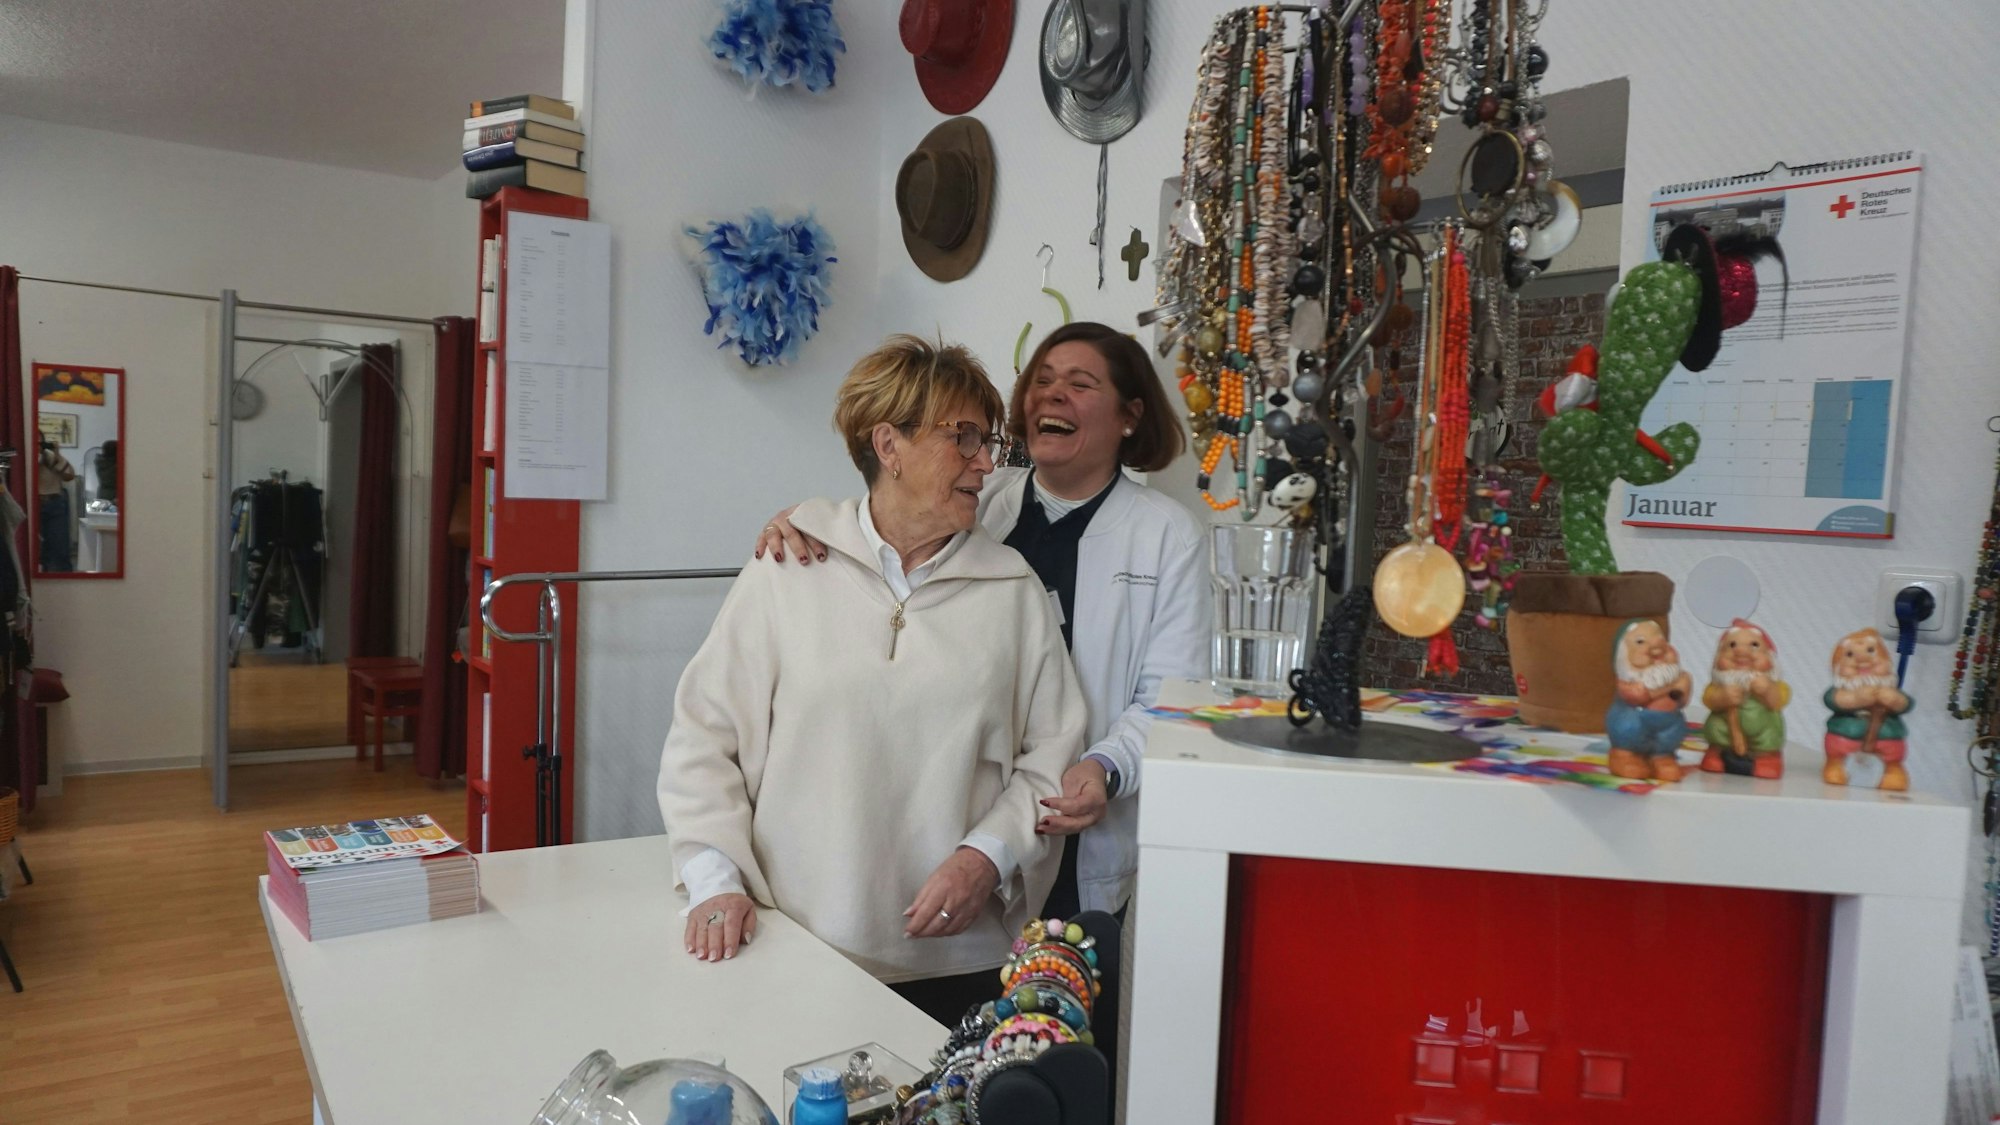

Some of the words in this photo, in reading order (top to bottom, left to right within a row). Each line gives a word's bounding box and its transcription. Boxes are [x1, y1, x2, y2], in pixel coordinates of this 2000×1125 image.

[1860, 186, 1912, 200] Deutsches
[1860, 198, 1888, 208] Rotes
[1860, 207, 1888, 216] Kreuz
[1626, 493, 1718, 518] Januar
[287, 842, 423, 863] Programm
